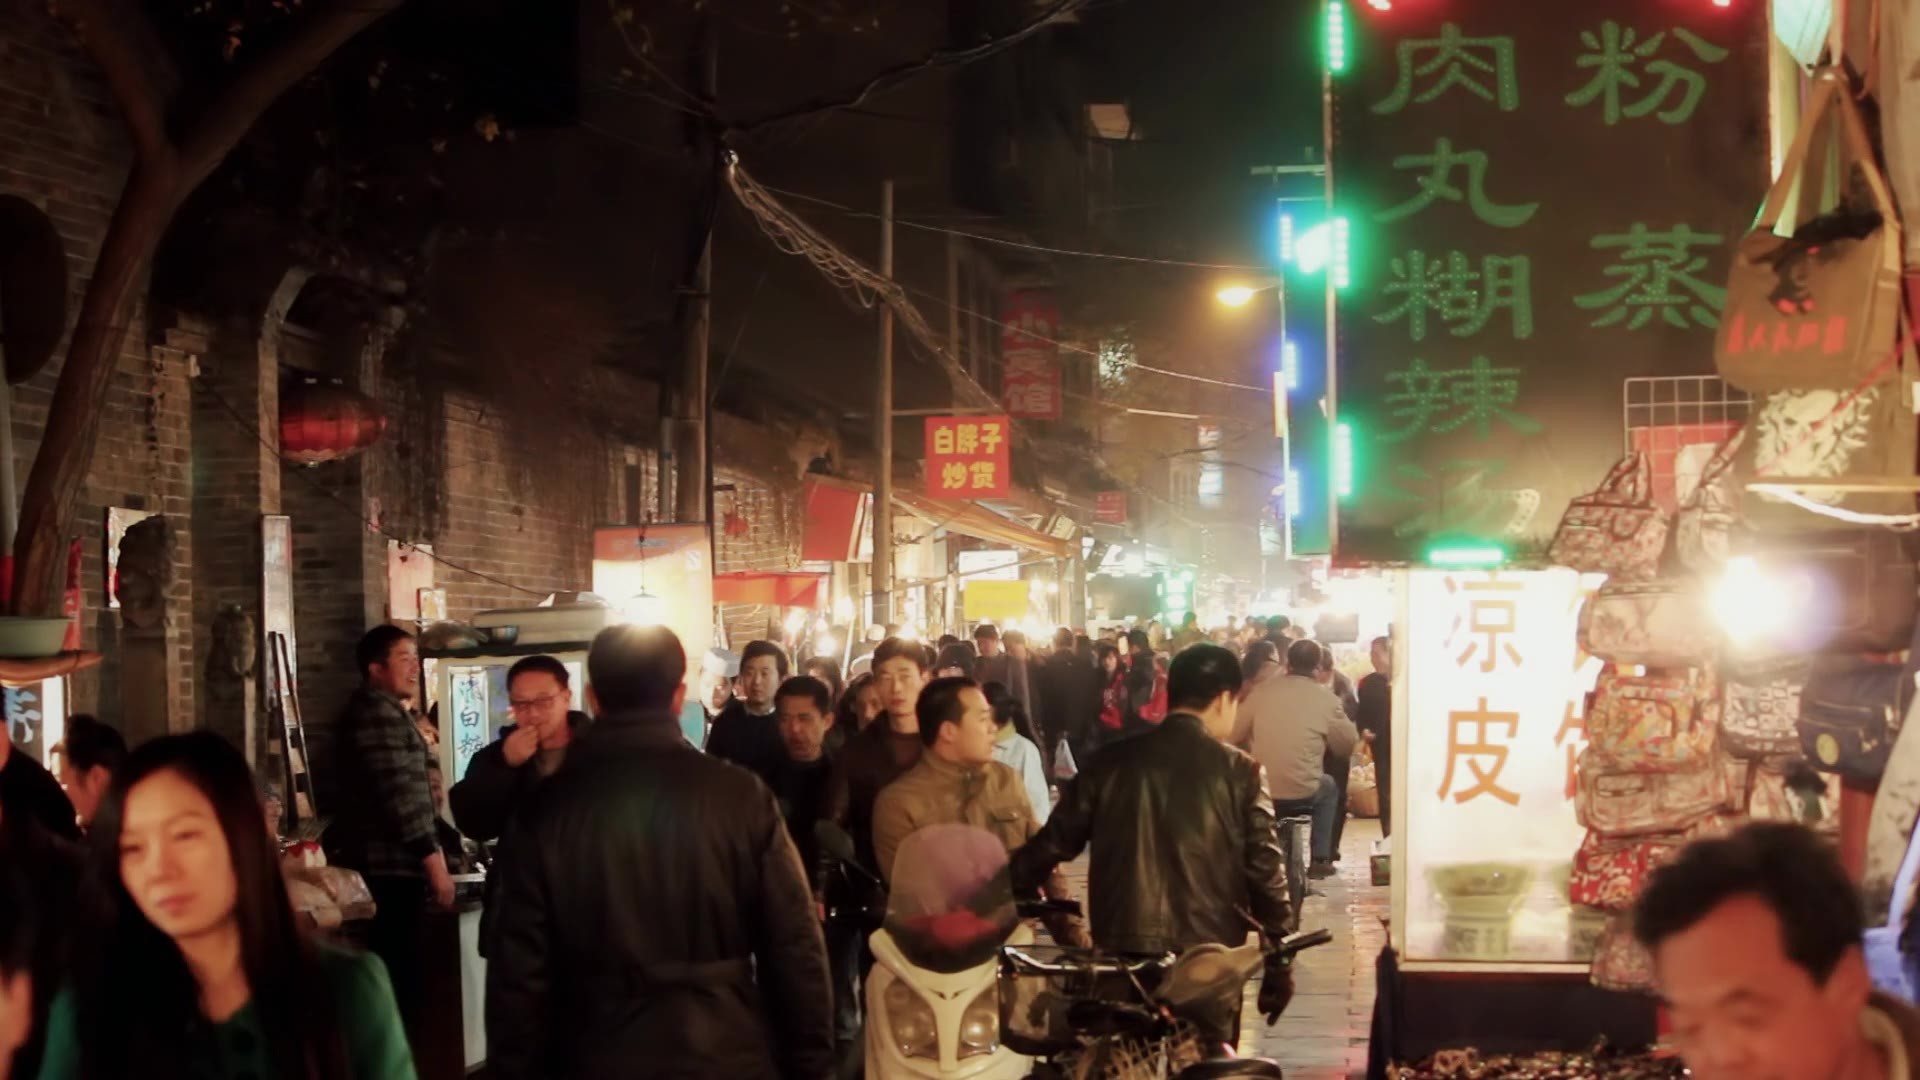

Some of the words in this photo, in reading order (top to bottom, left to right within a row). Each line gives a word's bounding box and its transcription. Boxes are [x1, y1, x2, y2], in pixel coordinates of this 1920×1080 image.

[934, 423, 1002, 454] 白胖子
[942, 461, 995, 489] 炒货
[1437, 571, 1524, 806] 凉皮
